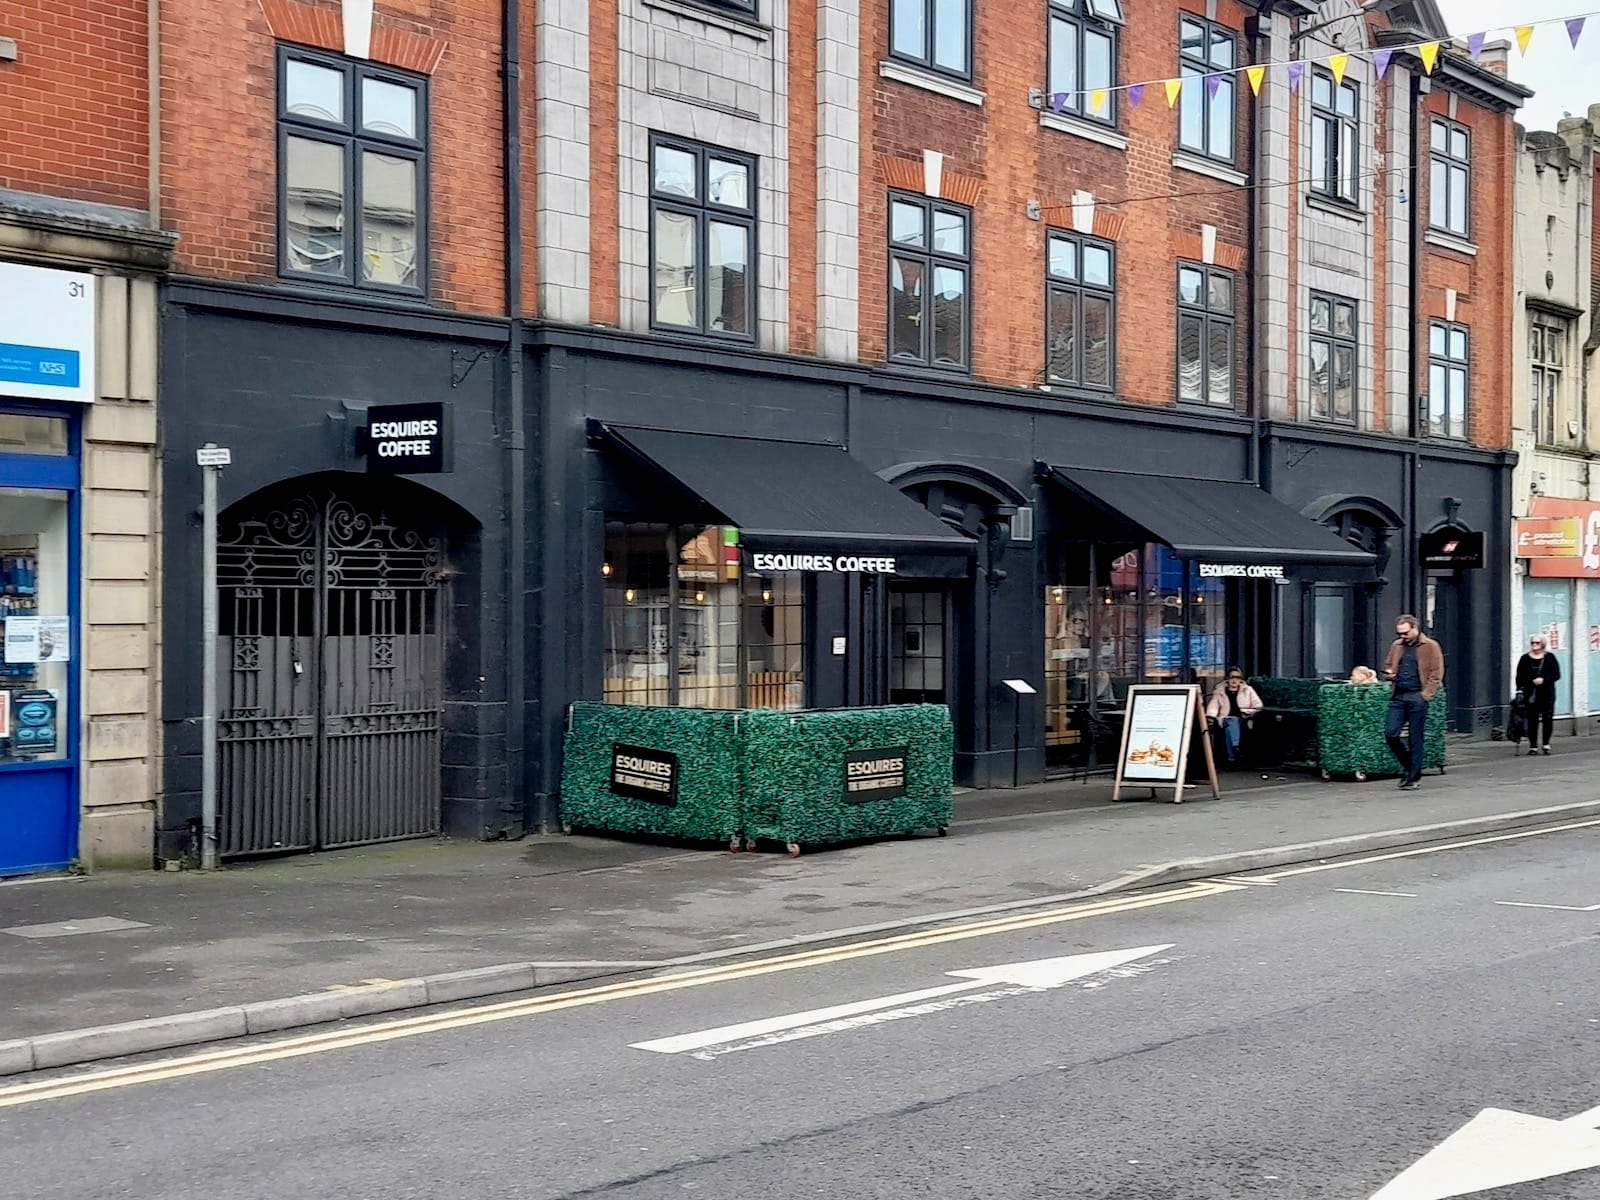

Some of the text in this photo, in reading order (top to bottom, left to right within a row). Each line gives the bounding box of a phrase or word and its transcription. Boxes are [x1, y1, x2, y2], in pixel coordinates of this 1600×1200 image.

[69, 281, 84, 298] 31
[41, 362, 65, 375] NHS
[371, 420, 438, 438] ESQUIRES
[378, 440, 431, 457] COFFEE
[753, 554, 896, 573] ESQUIRES COFFEE
[1247, 566, 1284, 578] COFFEE
[616, 755, 671, 776] ESQUIRES
[847, 758, 904, 776] ESQUIRES
